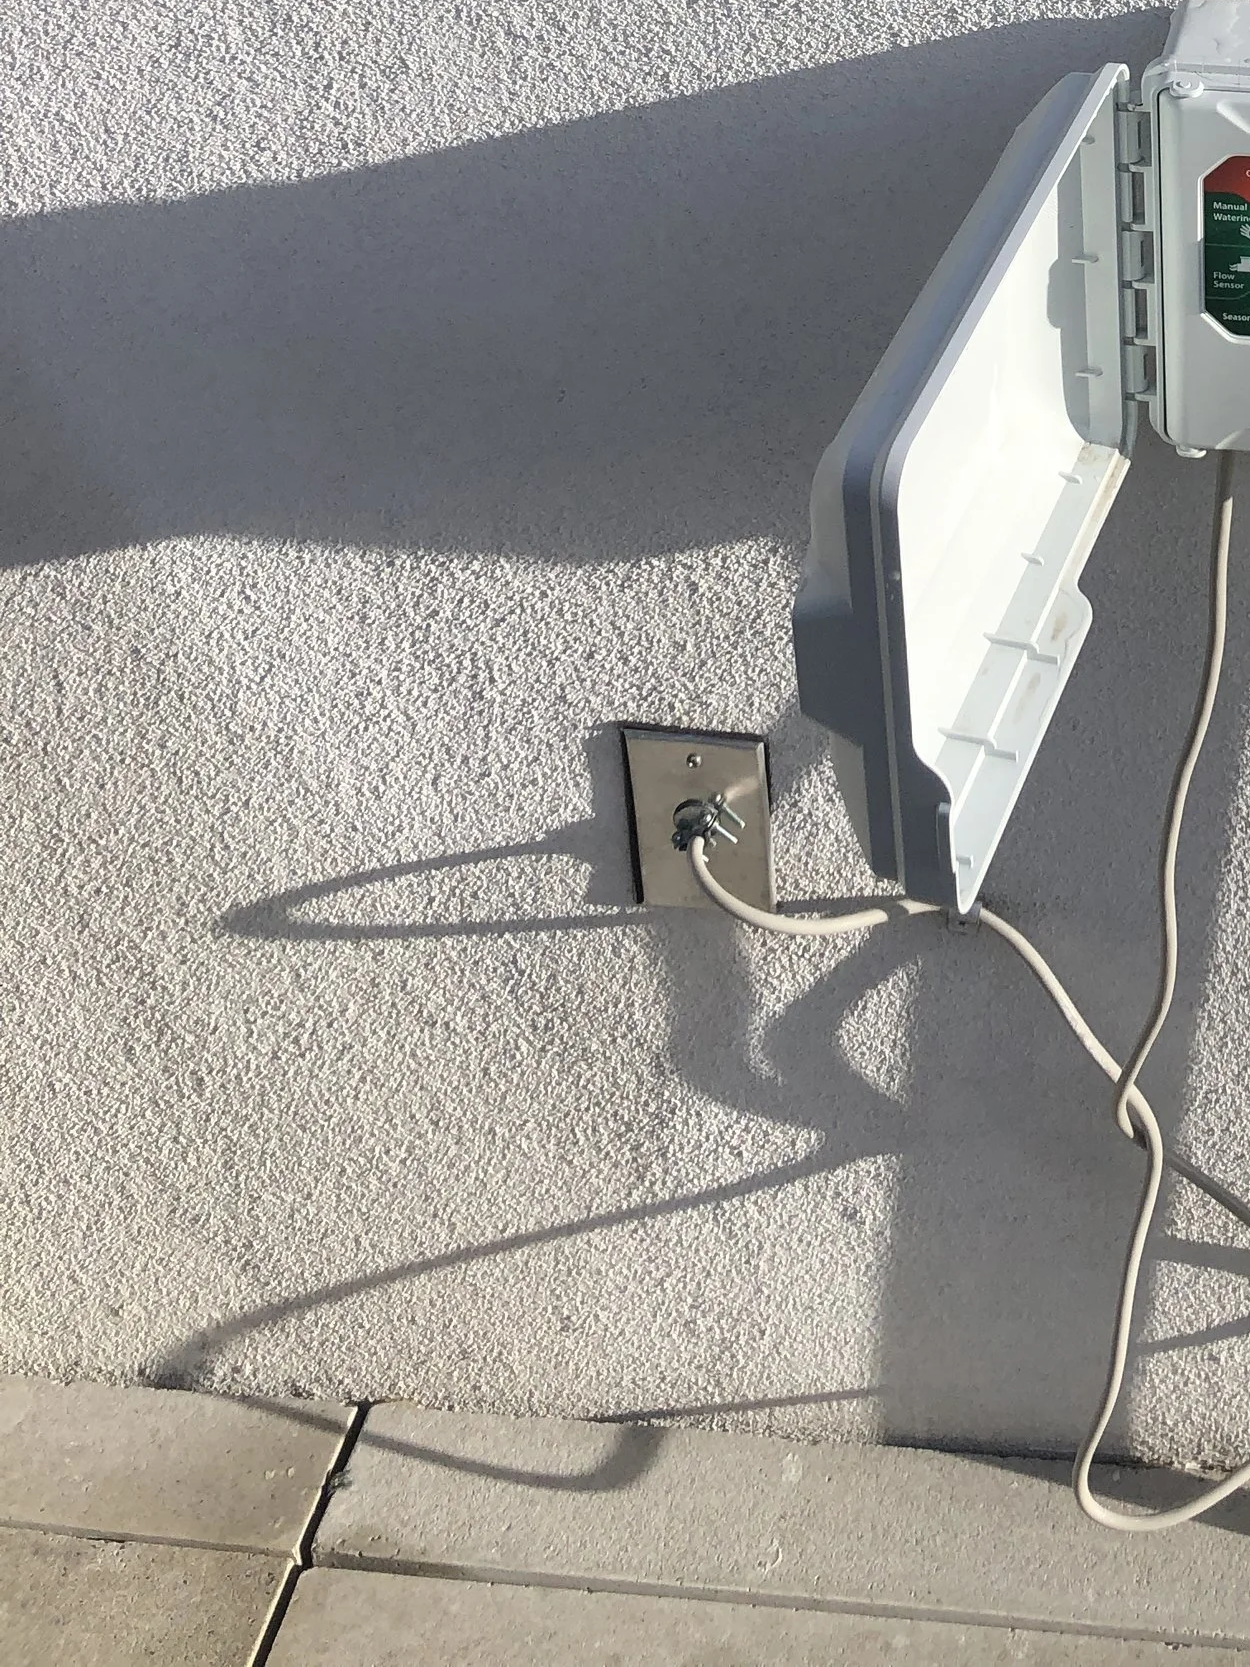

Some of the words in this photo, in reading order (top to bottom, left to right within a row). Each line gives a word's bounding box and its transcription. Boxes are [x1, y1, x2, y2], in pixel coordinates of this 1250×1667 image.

[1213, 202, 1248, 211] Manual
[1213, 272, 1235, 281] Flow
[1213, 281, 1244, 289] Sensor
